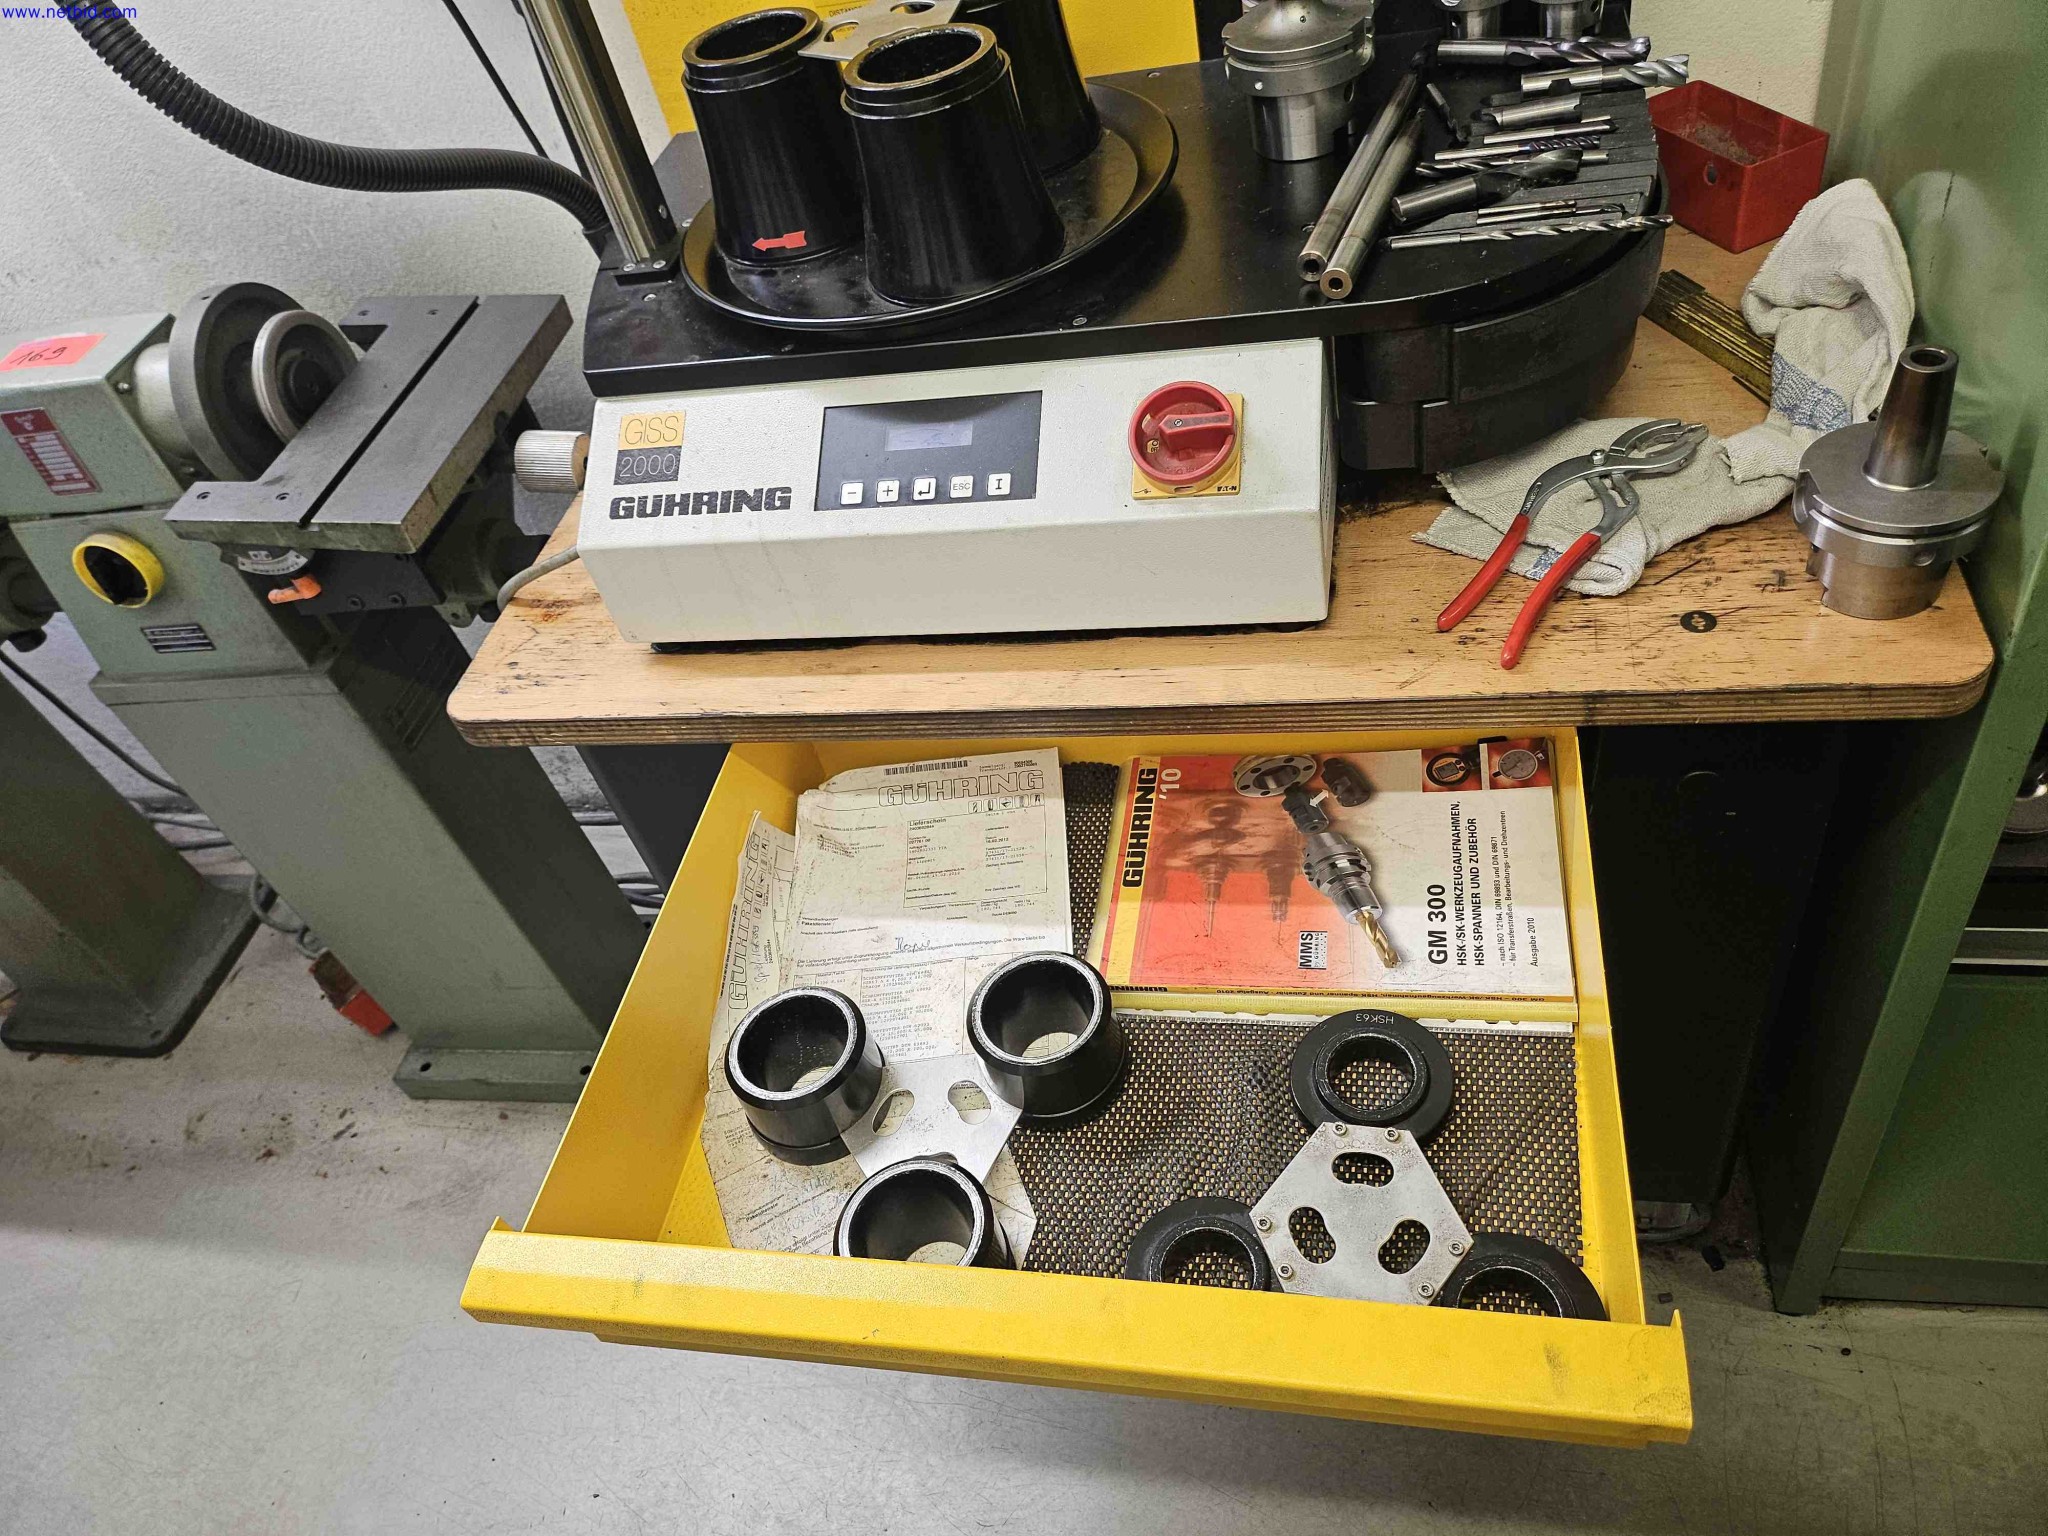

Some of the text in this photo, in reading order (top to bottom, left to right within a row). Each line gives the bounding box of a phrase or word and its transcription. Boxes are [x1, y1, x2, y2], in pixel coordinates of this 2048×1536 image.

[624, 415, 679, 445] GISS
[619, 453, 676, 477] 2000
[953, 483, 971, 491] ESC
[878, 769, 1044, 808] GÜHRING
[909, 818, 947, 826] Lieferschein
[1122, 768, 1158, 888] GÜHRING
[1490, 836, 1499, 853] 69871
[1491, 853, 1499, 866] DIN
[1450, 800, 1467, 966] HSK-/SK-WERKZEUGAUFNAHMEN,
[1492, 866, 1500, 879] und
[1465, 818, 1485, 966] HSK-SPANNER UND ZUBEHÖR
[1492, 879, 1501, 898] 69893
[1499, 810, 1517, 962] für Transferstraßen, Bearbeitungs- und Drehzentren
[1494, 898, 1502, 910] DIN
[728, 831, 761, 1010] GÜHRING
[1427, 884, 1448, 965] GM 300
[1299, 932, 1314, 967] MMS
[1497, 932, 1505, 945] ISO
[1526, 917, 1539, 967] Ausgabe 2010
[1498, 947, 1506, 962] nach
[1355, 1013, 1394, 1025] HSK63
